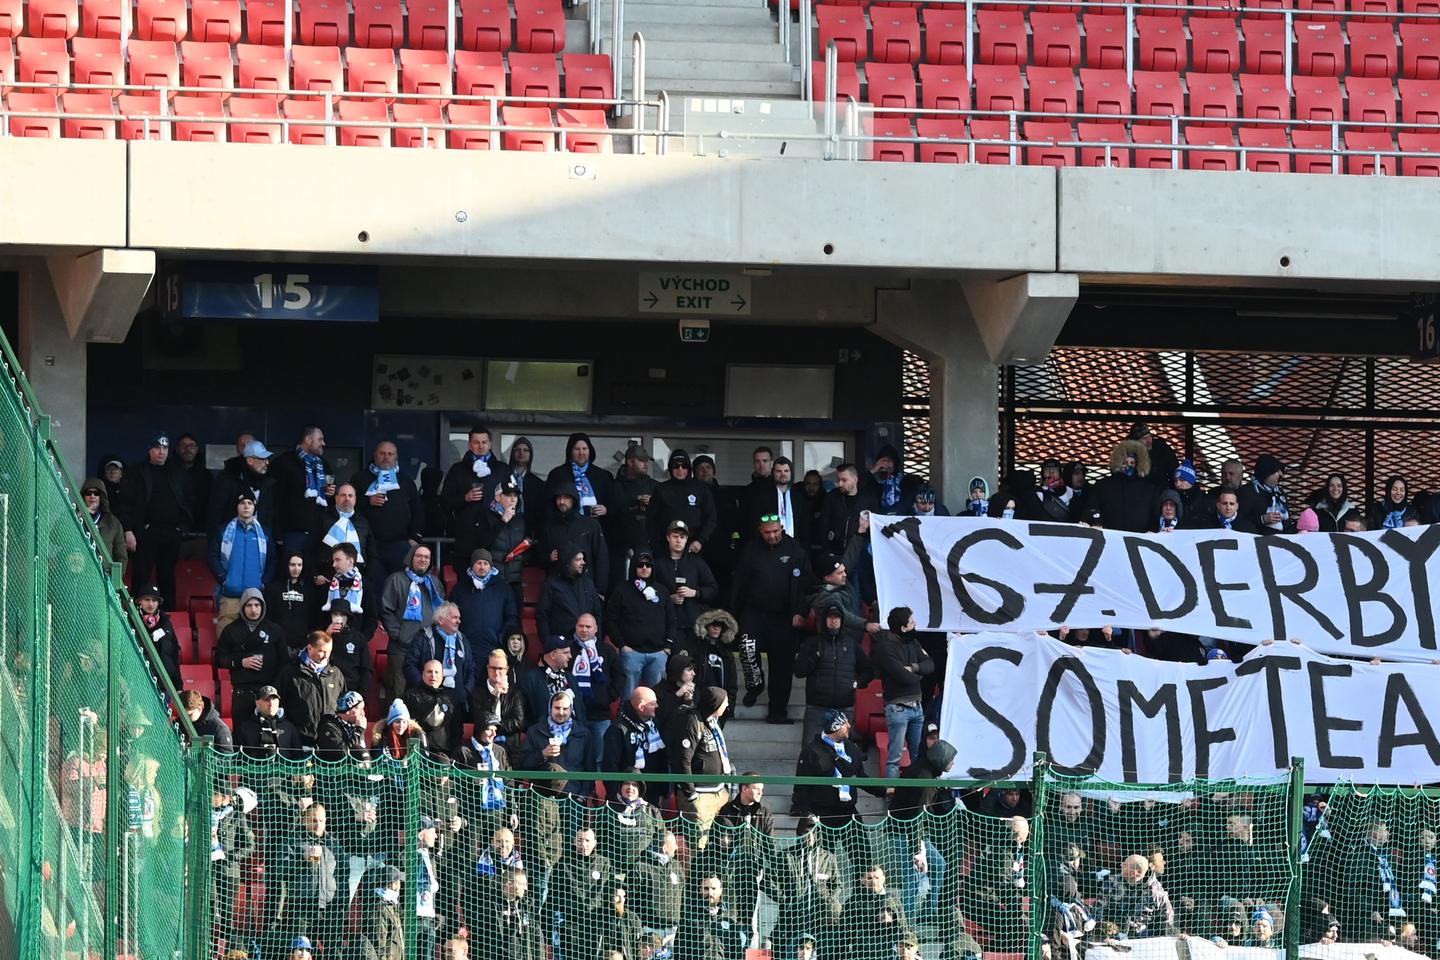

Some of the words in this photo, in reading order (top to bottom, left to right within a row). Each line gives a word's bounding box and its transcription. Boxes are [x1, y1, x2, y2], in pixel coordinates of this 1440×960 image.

[254, 273, 312, 310] 15
[660, 275, 731, 292] VÝCHOD
[676, 295, 713, 309] EXIT
[881, 517, 1116, 629] 167.
